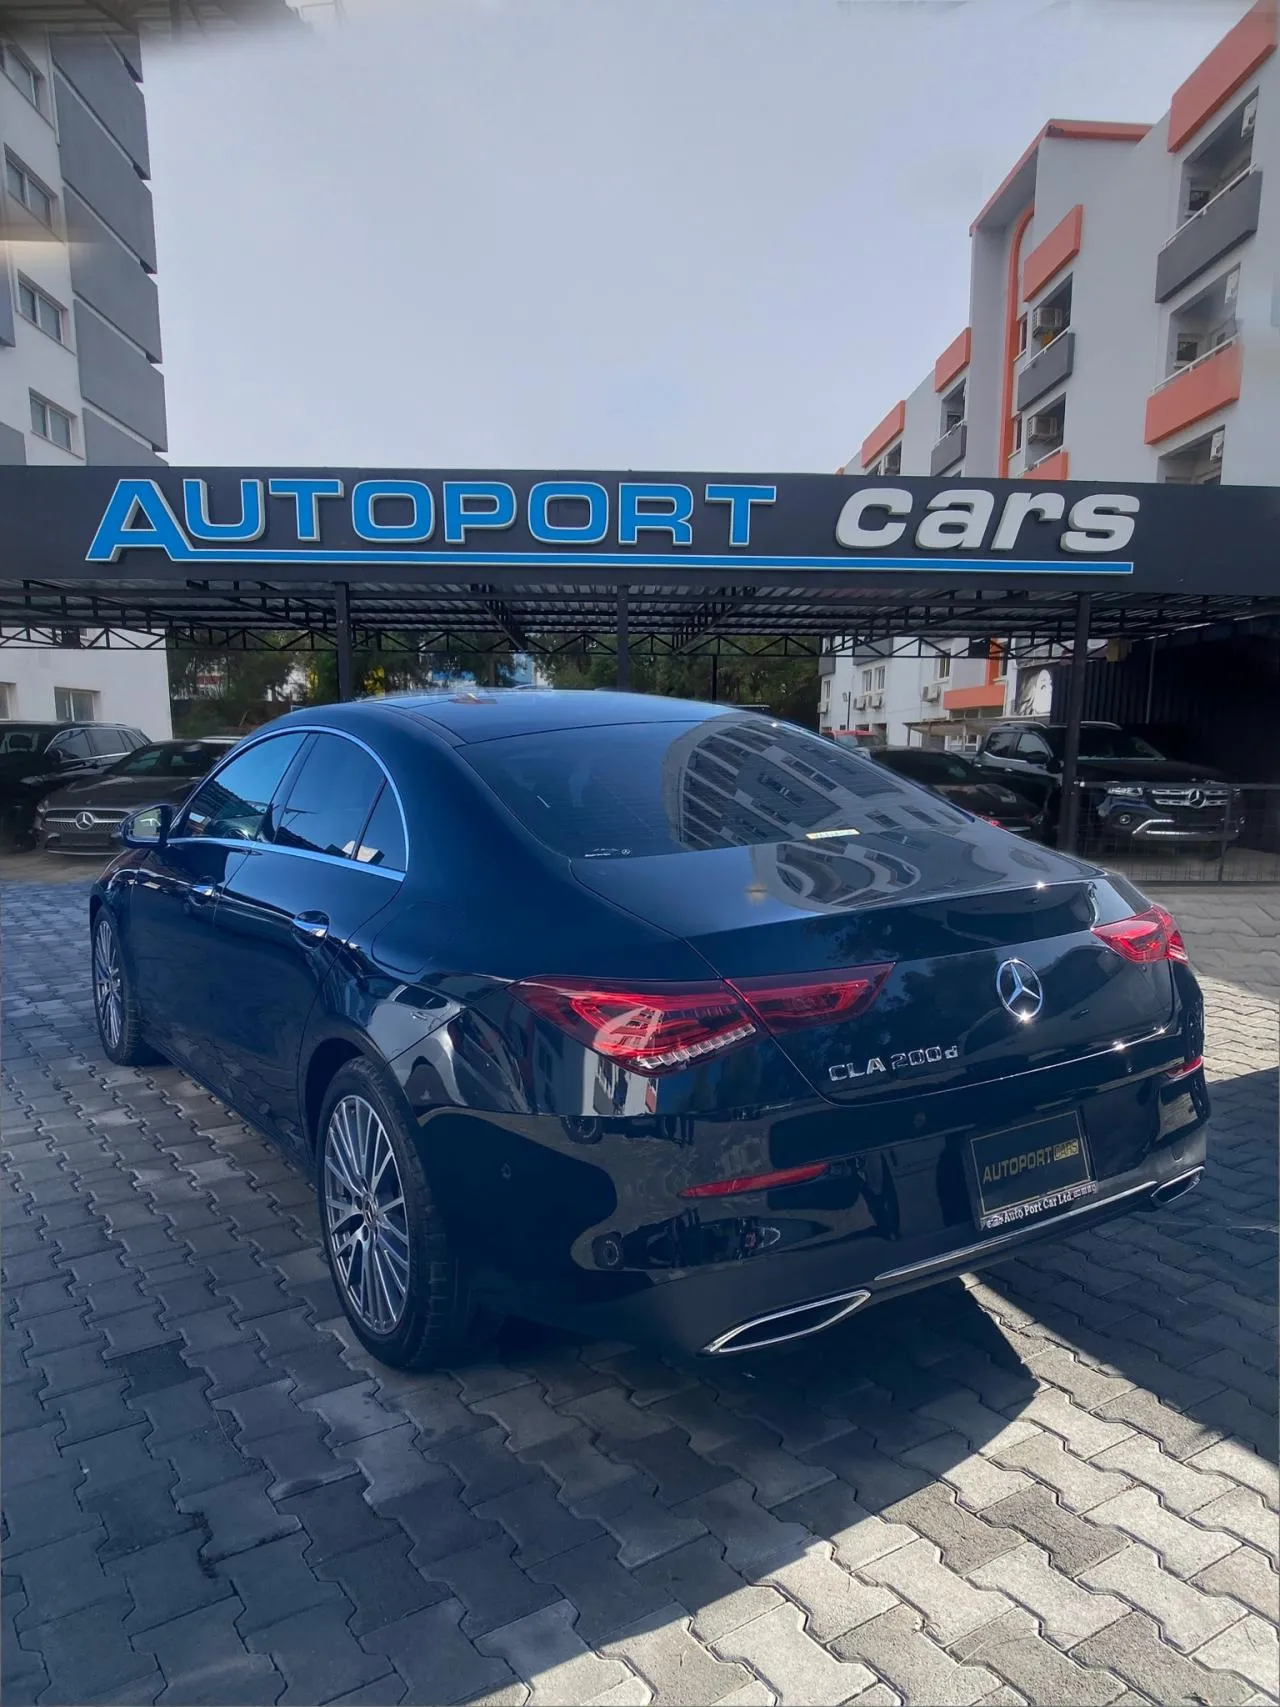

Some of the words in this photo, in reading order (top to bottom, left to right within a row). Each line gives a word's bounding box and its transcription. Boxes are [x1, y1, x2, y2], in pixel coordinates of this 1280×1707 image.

[85, 478, 777, 562] AUTOPORT
[836, 487, 1141, 553] cars
[828, 1057, 886, 1082] CLA
[983, 1147, 1052, 1184] AUTOPORT
[1024, 1202, 1042, 1216] Port
[1043, 1197, 1058, 1210] Car
